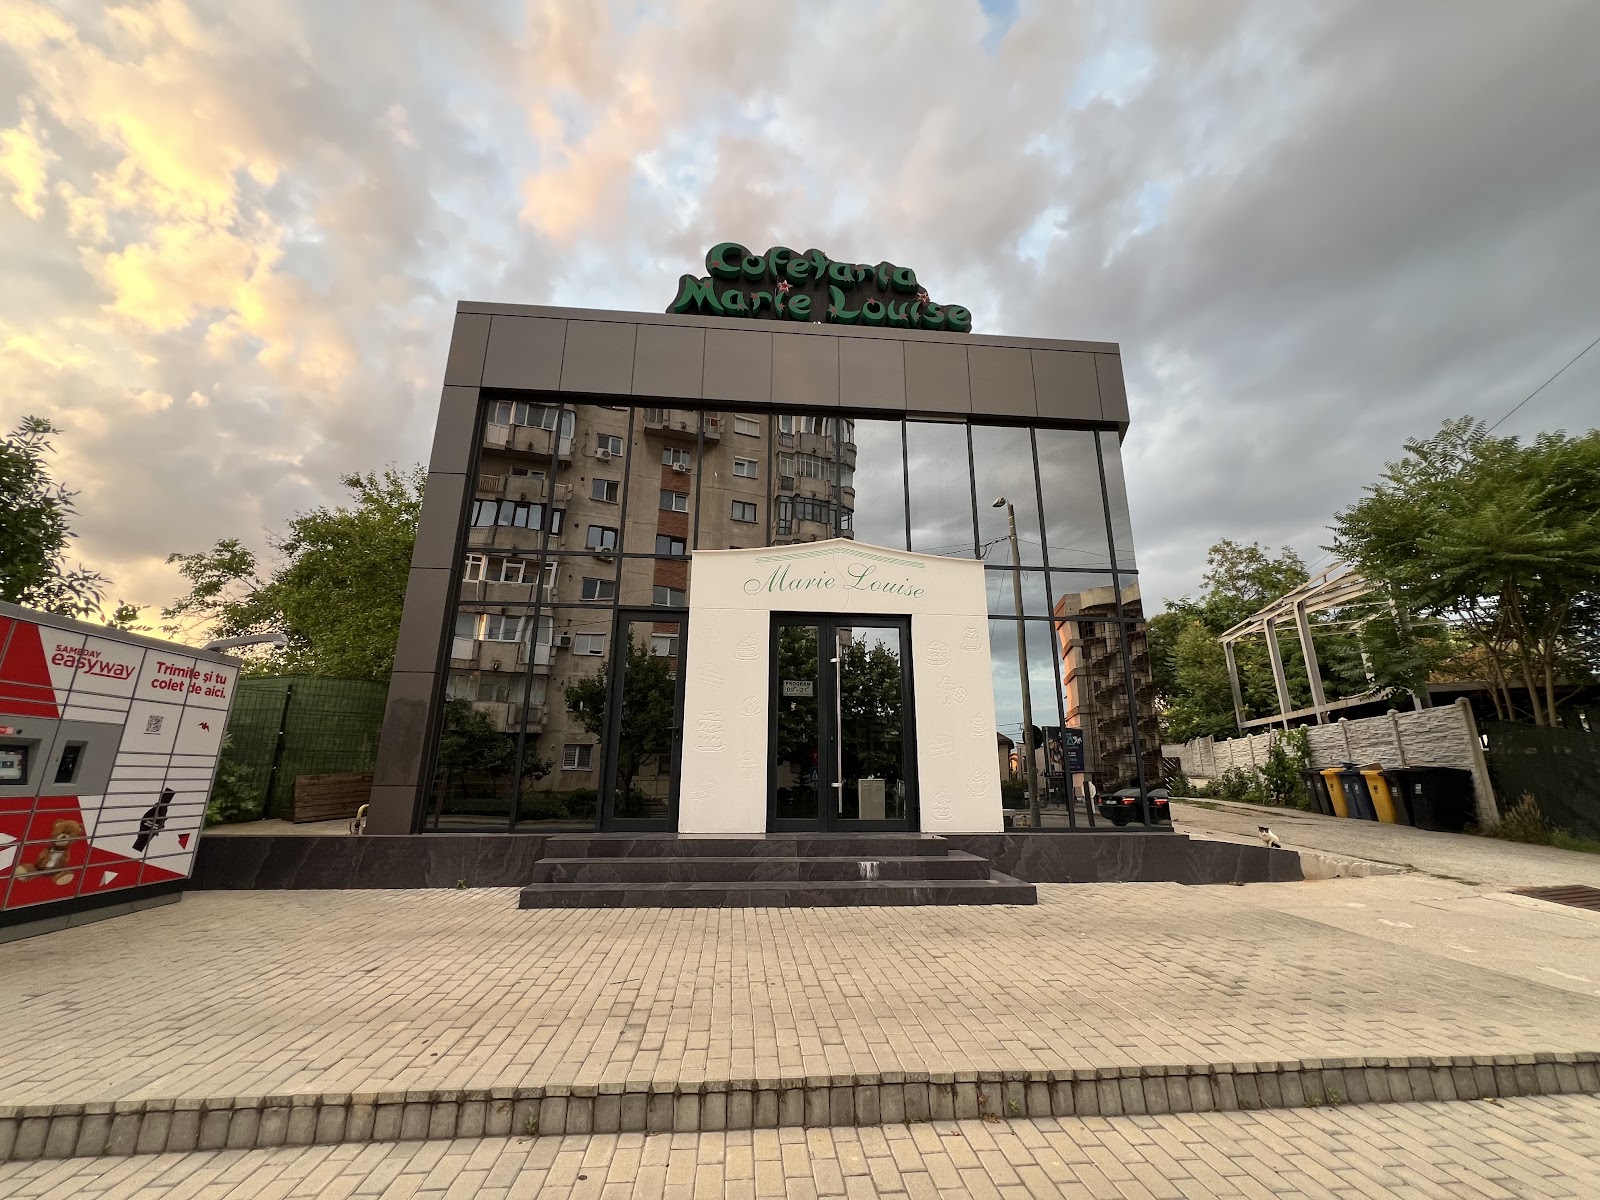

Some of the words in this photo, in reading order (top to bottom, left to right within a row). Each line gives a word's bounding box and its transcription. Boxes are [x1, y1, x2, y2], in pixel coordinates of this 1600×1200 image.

[672, 275, 812, 321] Marie
[826, 285, 972, 331] Louise
[743, 563, 836, 596] Marie
[843, 562, 926, 599] Louise
[55, 644, 102, 659] SAMEDAY
[51, 652, 136, 680] easyway
[157, 661, 201, 680] Trimite
[215, 673, 228, 685] tu
[151, 678, 185, 692] colet
[188, 682, 202, 695] de
[204, 685, 226, 699] aici.
